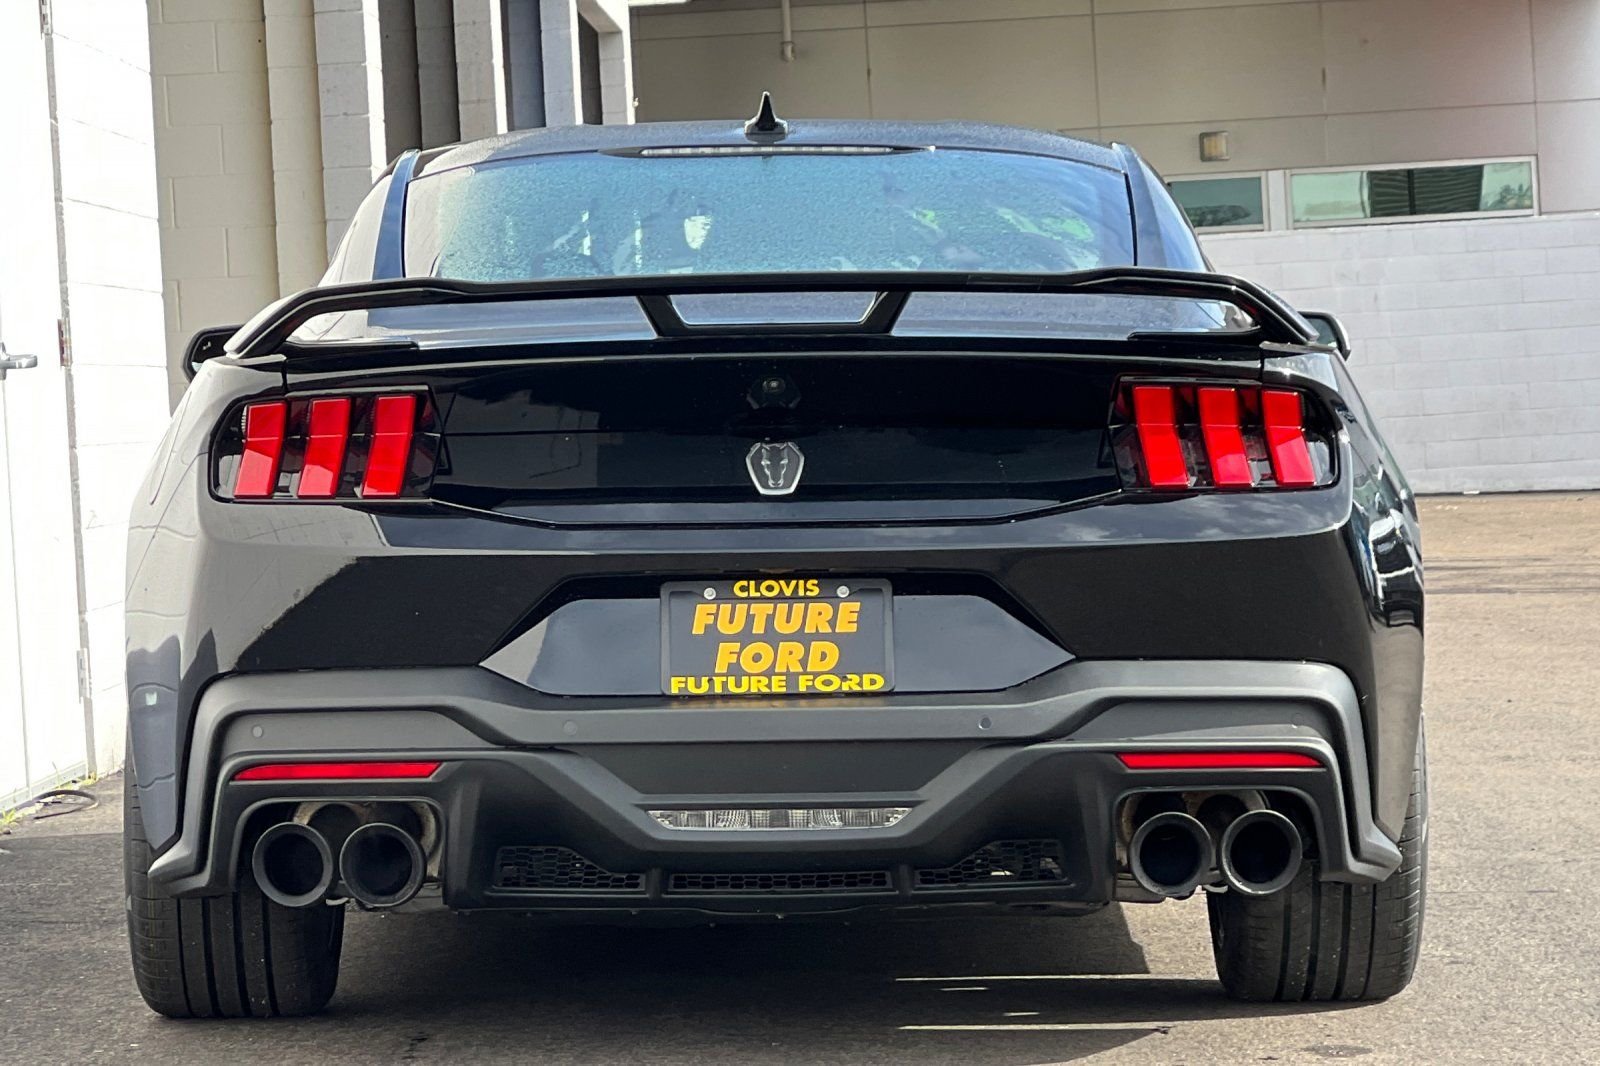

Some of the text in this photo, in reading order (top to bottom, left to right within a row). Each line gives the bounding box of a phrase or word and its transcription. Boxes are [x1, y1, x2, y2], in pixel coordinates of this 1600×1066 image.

[733, 579, 820, 597] CLOVIS
[691, 601, 861, 635] FUTURE
[714, 641, 840, 674] FORD
[670, 673, 885, 694] FUTURE FORD
